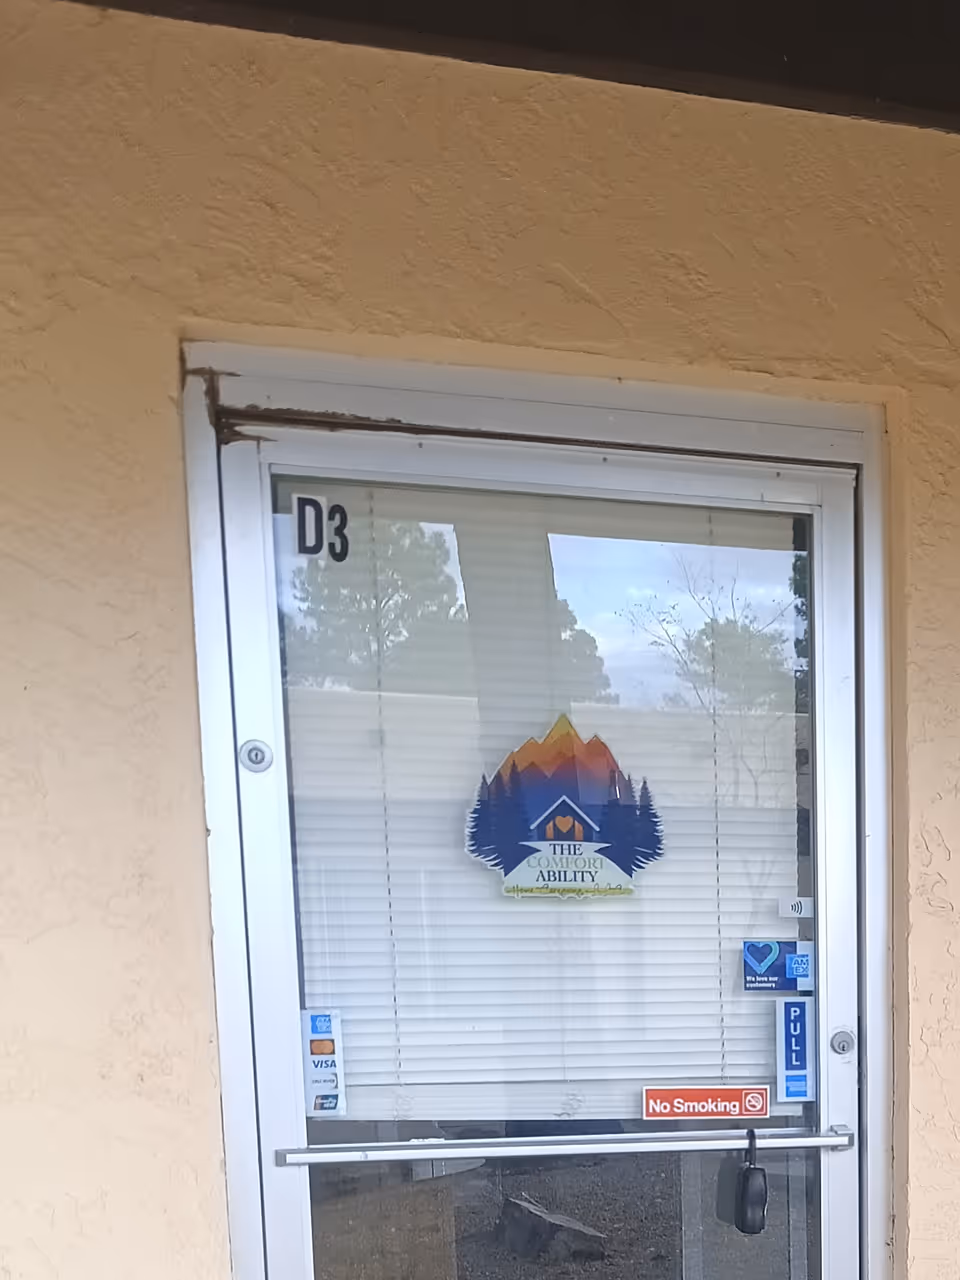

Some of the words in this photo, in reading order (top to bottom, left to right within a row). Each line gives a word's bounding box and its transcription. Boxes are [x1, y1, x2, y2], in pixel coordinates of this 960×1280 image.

[297, 496, 349, 563] D3
[549, 844, 583, 855] THE
[527, 856, 604, 869] COMFORT
[536, 870, 598, 882] ABILITY
[790, 1008, 801, 1065] PULL
[312, 1060, 337, 1069] VISA
[648, 1099, 671, 1114] No
[673, 1098, 740, 1115] Smoking
